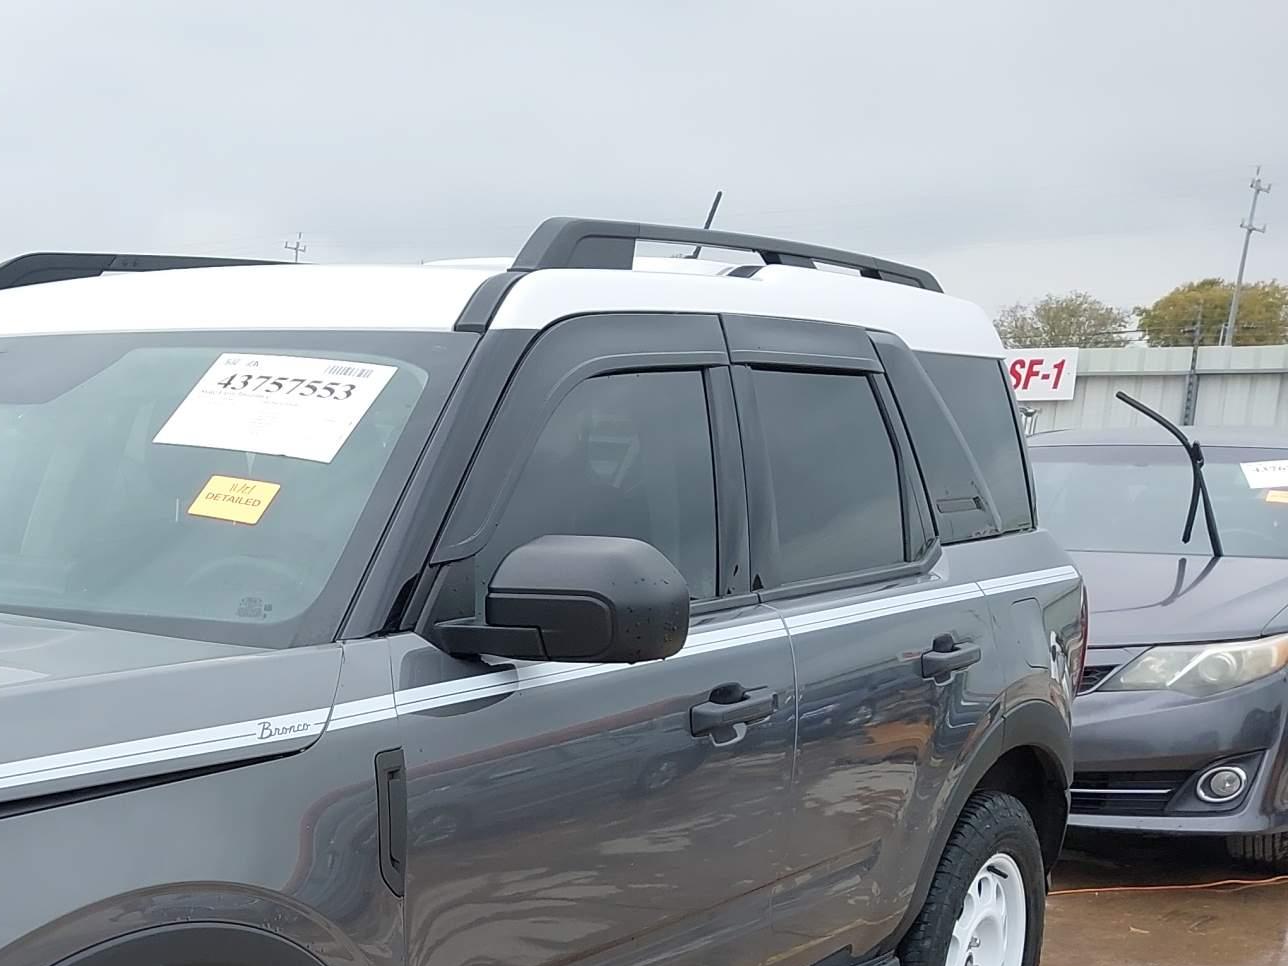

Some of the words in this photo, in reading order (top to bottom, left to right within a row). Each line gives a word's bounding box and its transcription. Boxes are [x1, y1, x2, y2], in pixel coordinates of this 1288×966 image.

[1009, 358, 1065, 390] SF-1
[217, 373, 357, 401] 43757553
[205, 491, 262, 507] DETAILED
[257, 721, 311, 740] Bronco
